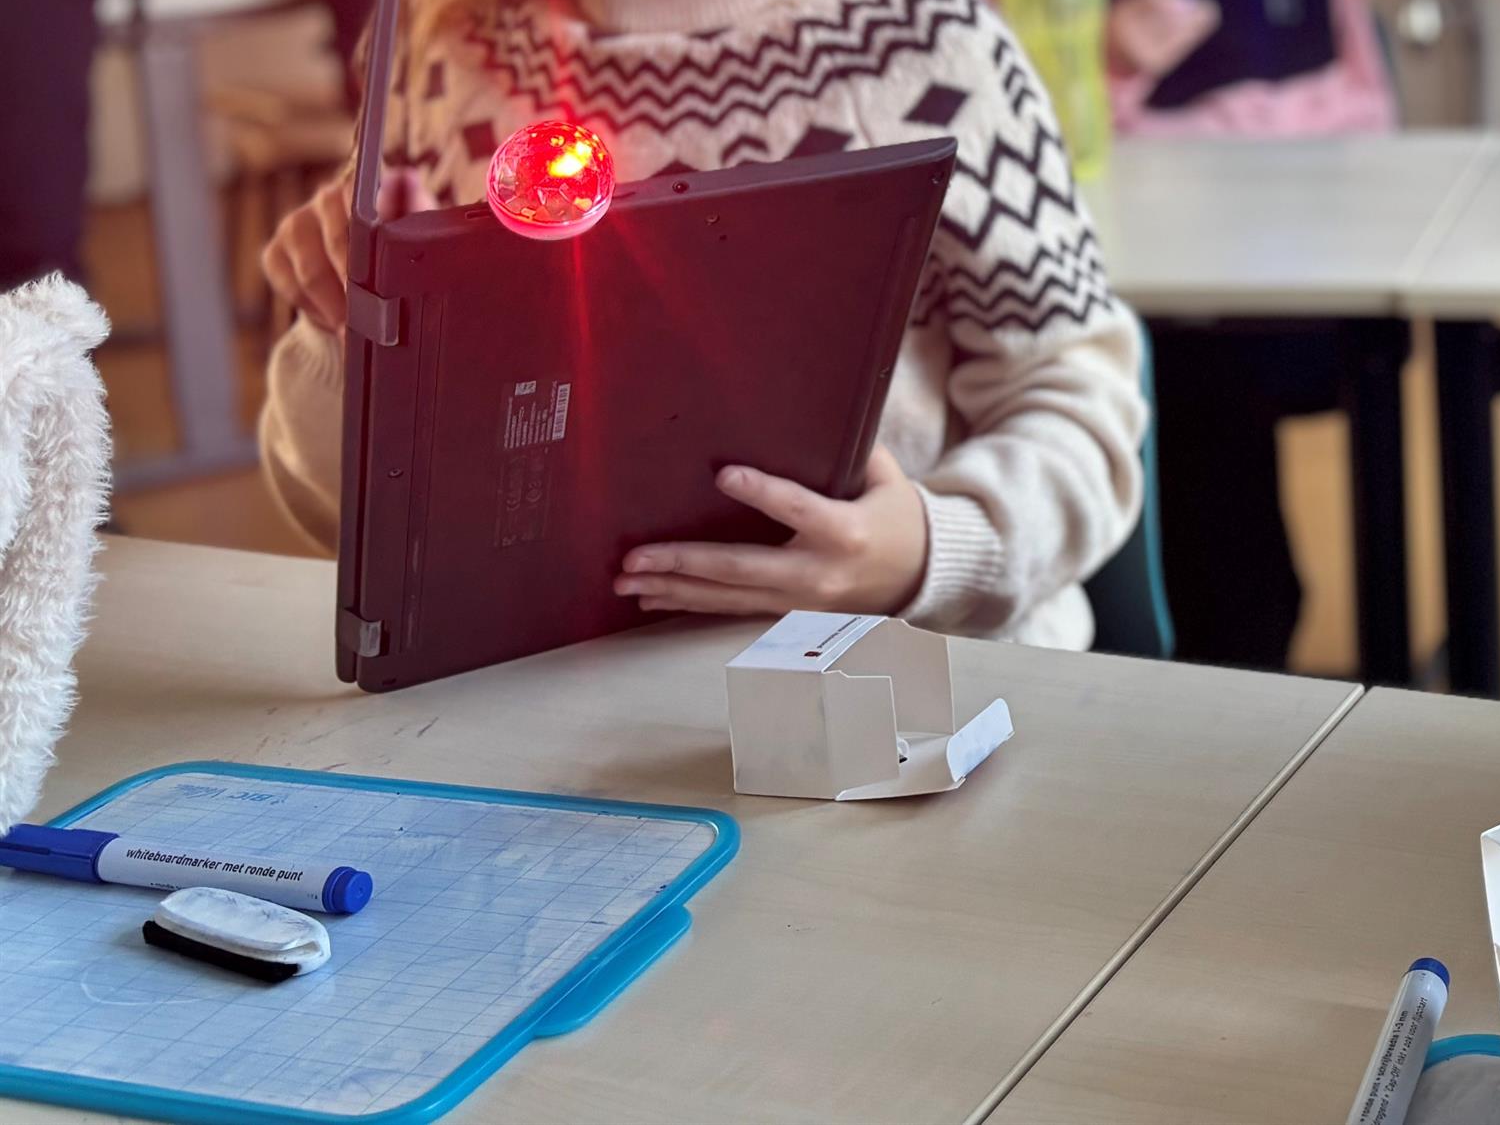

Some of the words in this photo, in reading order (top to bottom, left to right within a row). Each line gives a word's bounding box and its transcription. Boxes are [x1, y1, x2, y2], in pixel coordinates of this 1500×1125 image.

[126, 848, 222, 870] whiteboardmarker
[222, 862, 245, 874] met
[244, 865, 277, 879] ronde
[276, 868, 304, 882] punt
[1398, 1010, 1409, 1022] mm
